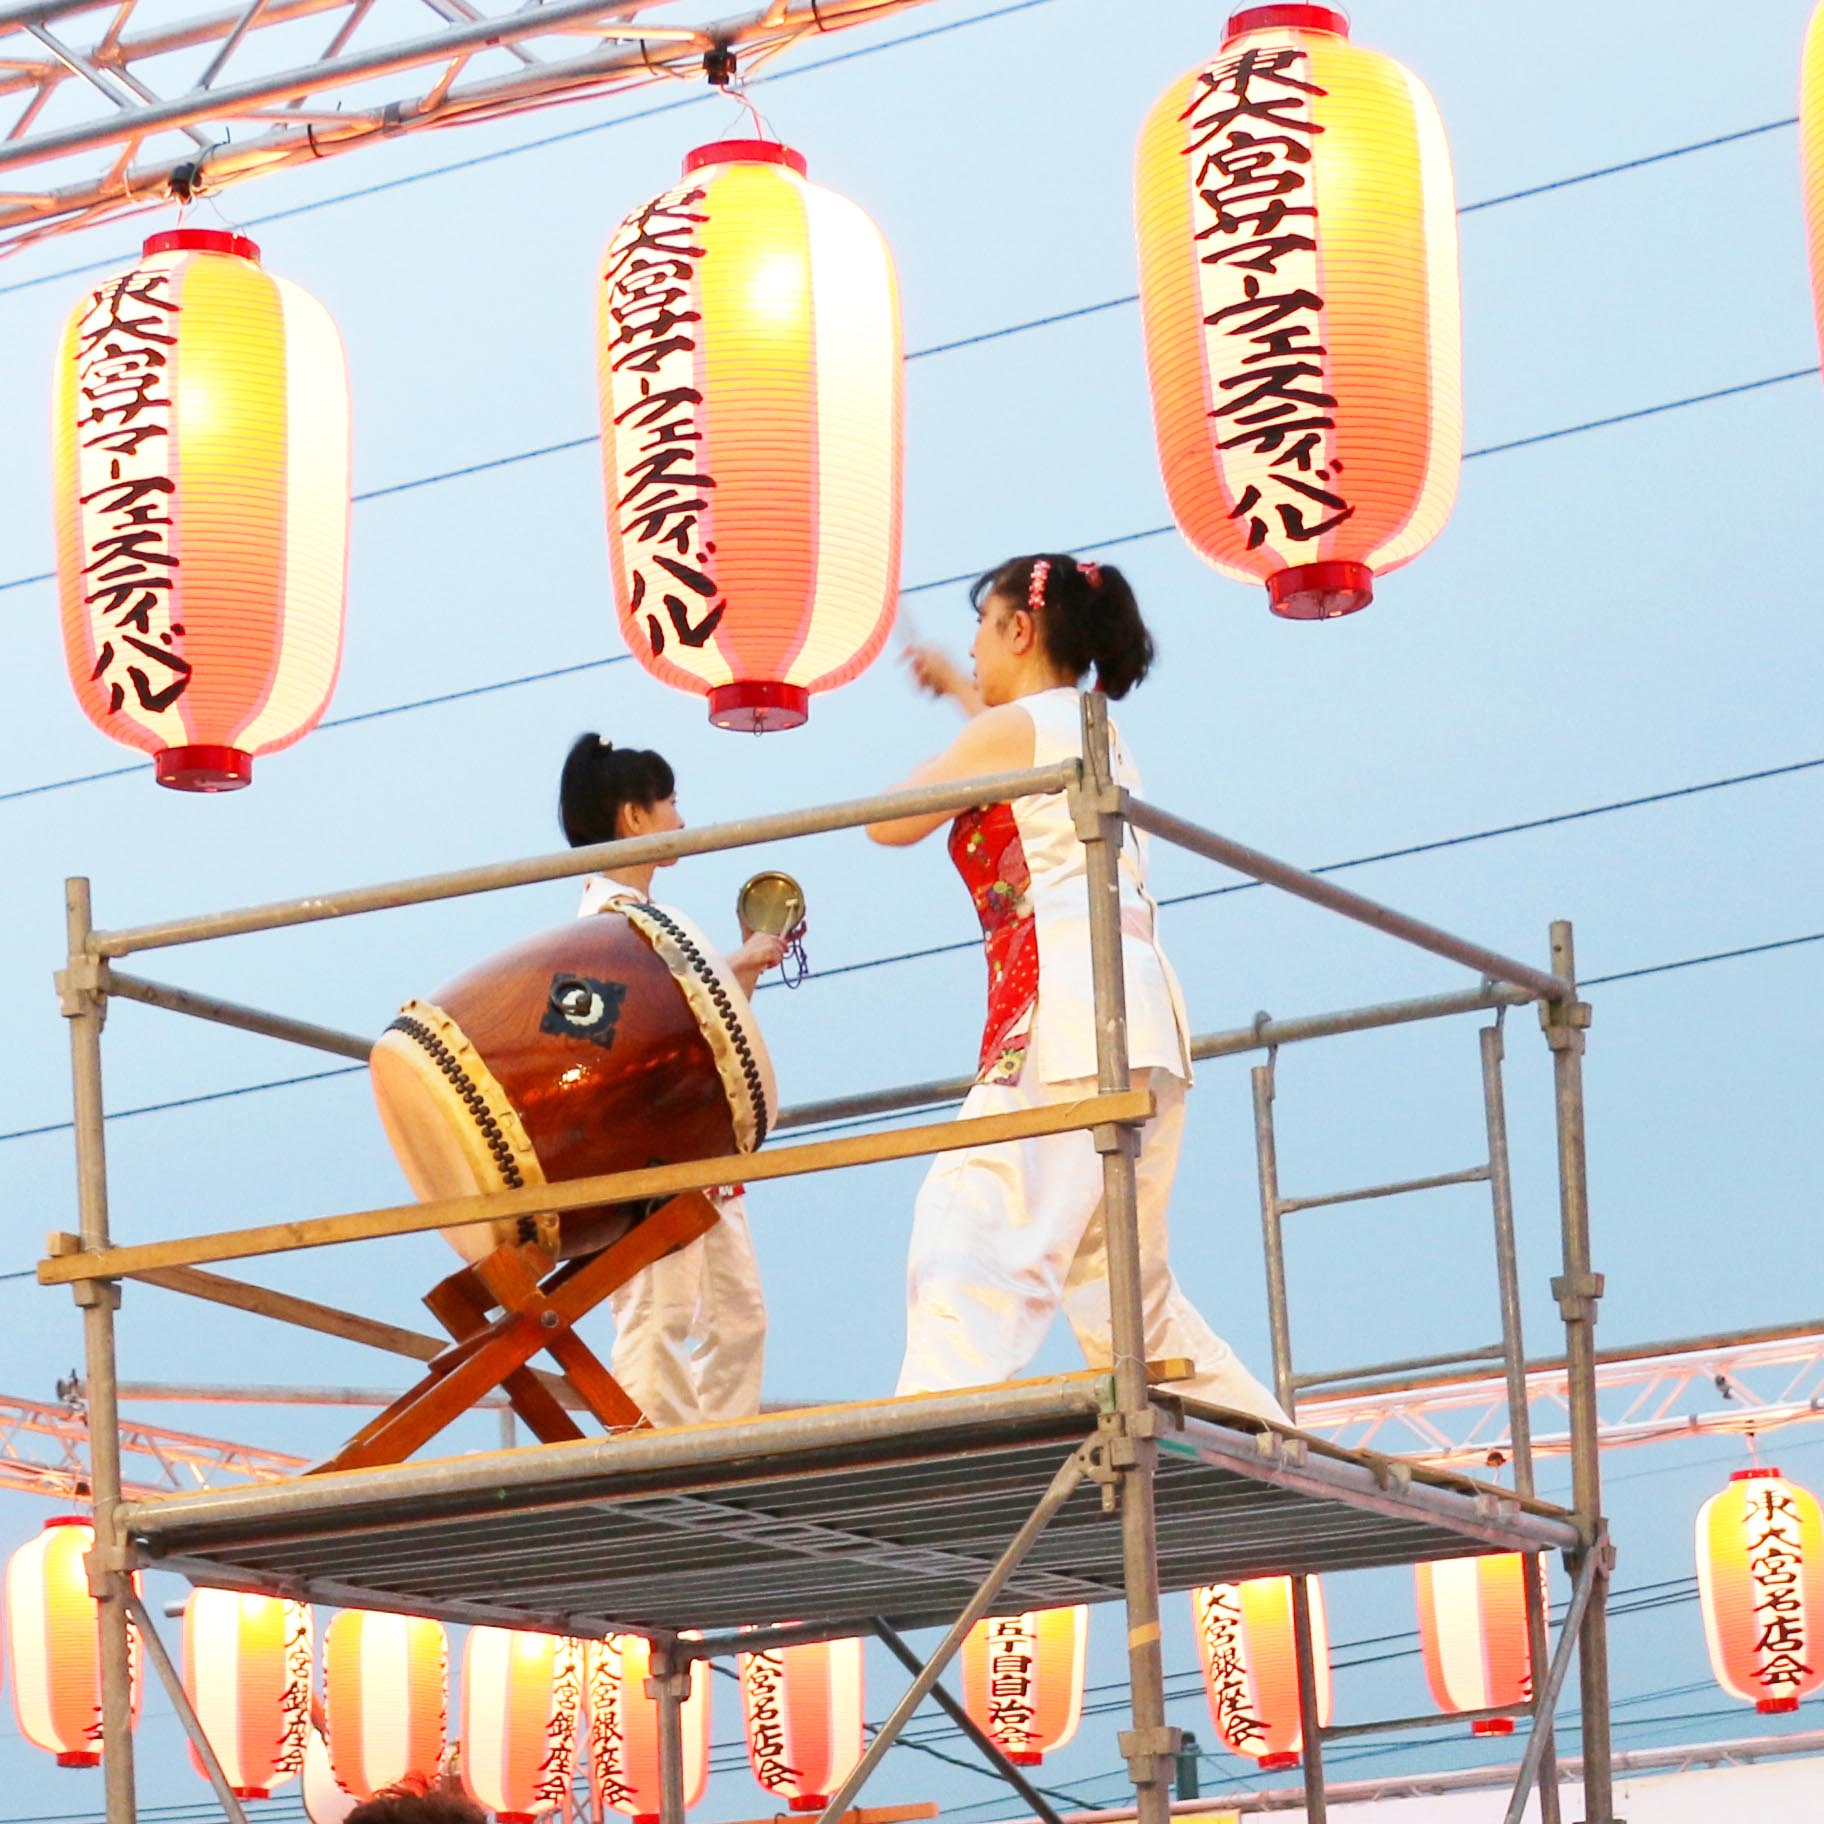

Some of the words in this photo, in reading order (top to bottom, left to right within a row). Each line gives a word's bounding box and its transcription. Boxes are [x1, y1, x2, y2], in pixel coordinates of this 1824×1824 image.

[76, 267, 191, 715] 東大宮サマーフェスティバル
[607, 182, 726, 657] 東大宮サマーフェスティバル
[1181, 48, 1356, 549] 東大宮サマーフェスティバル
[1741, 1488, 1813, 1687] 東大宮名店会
